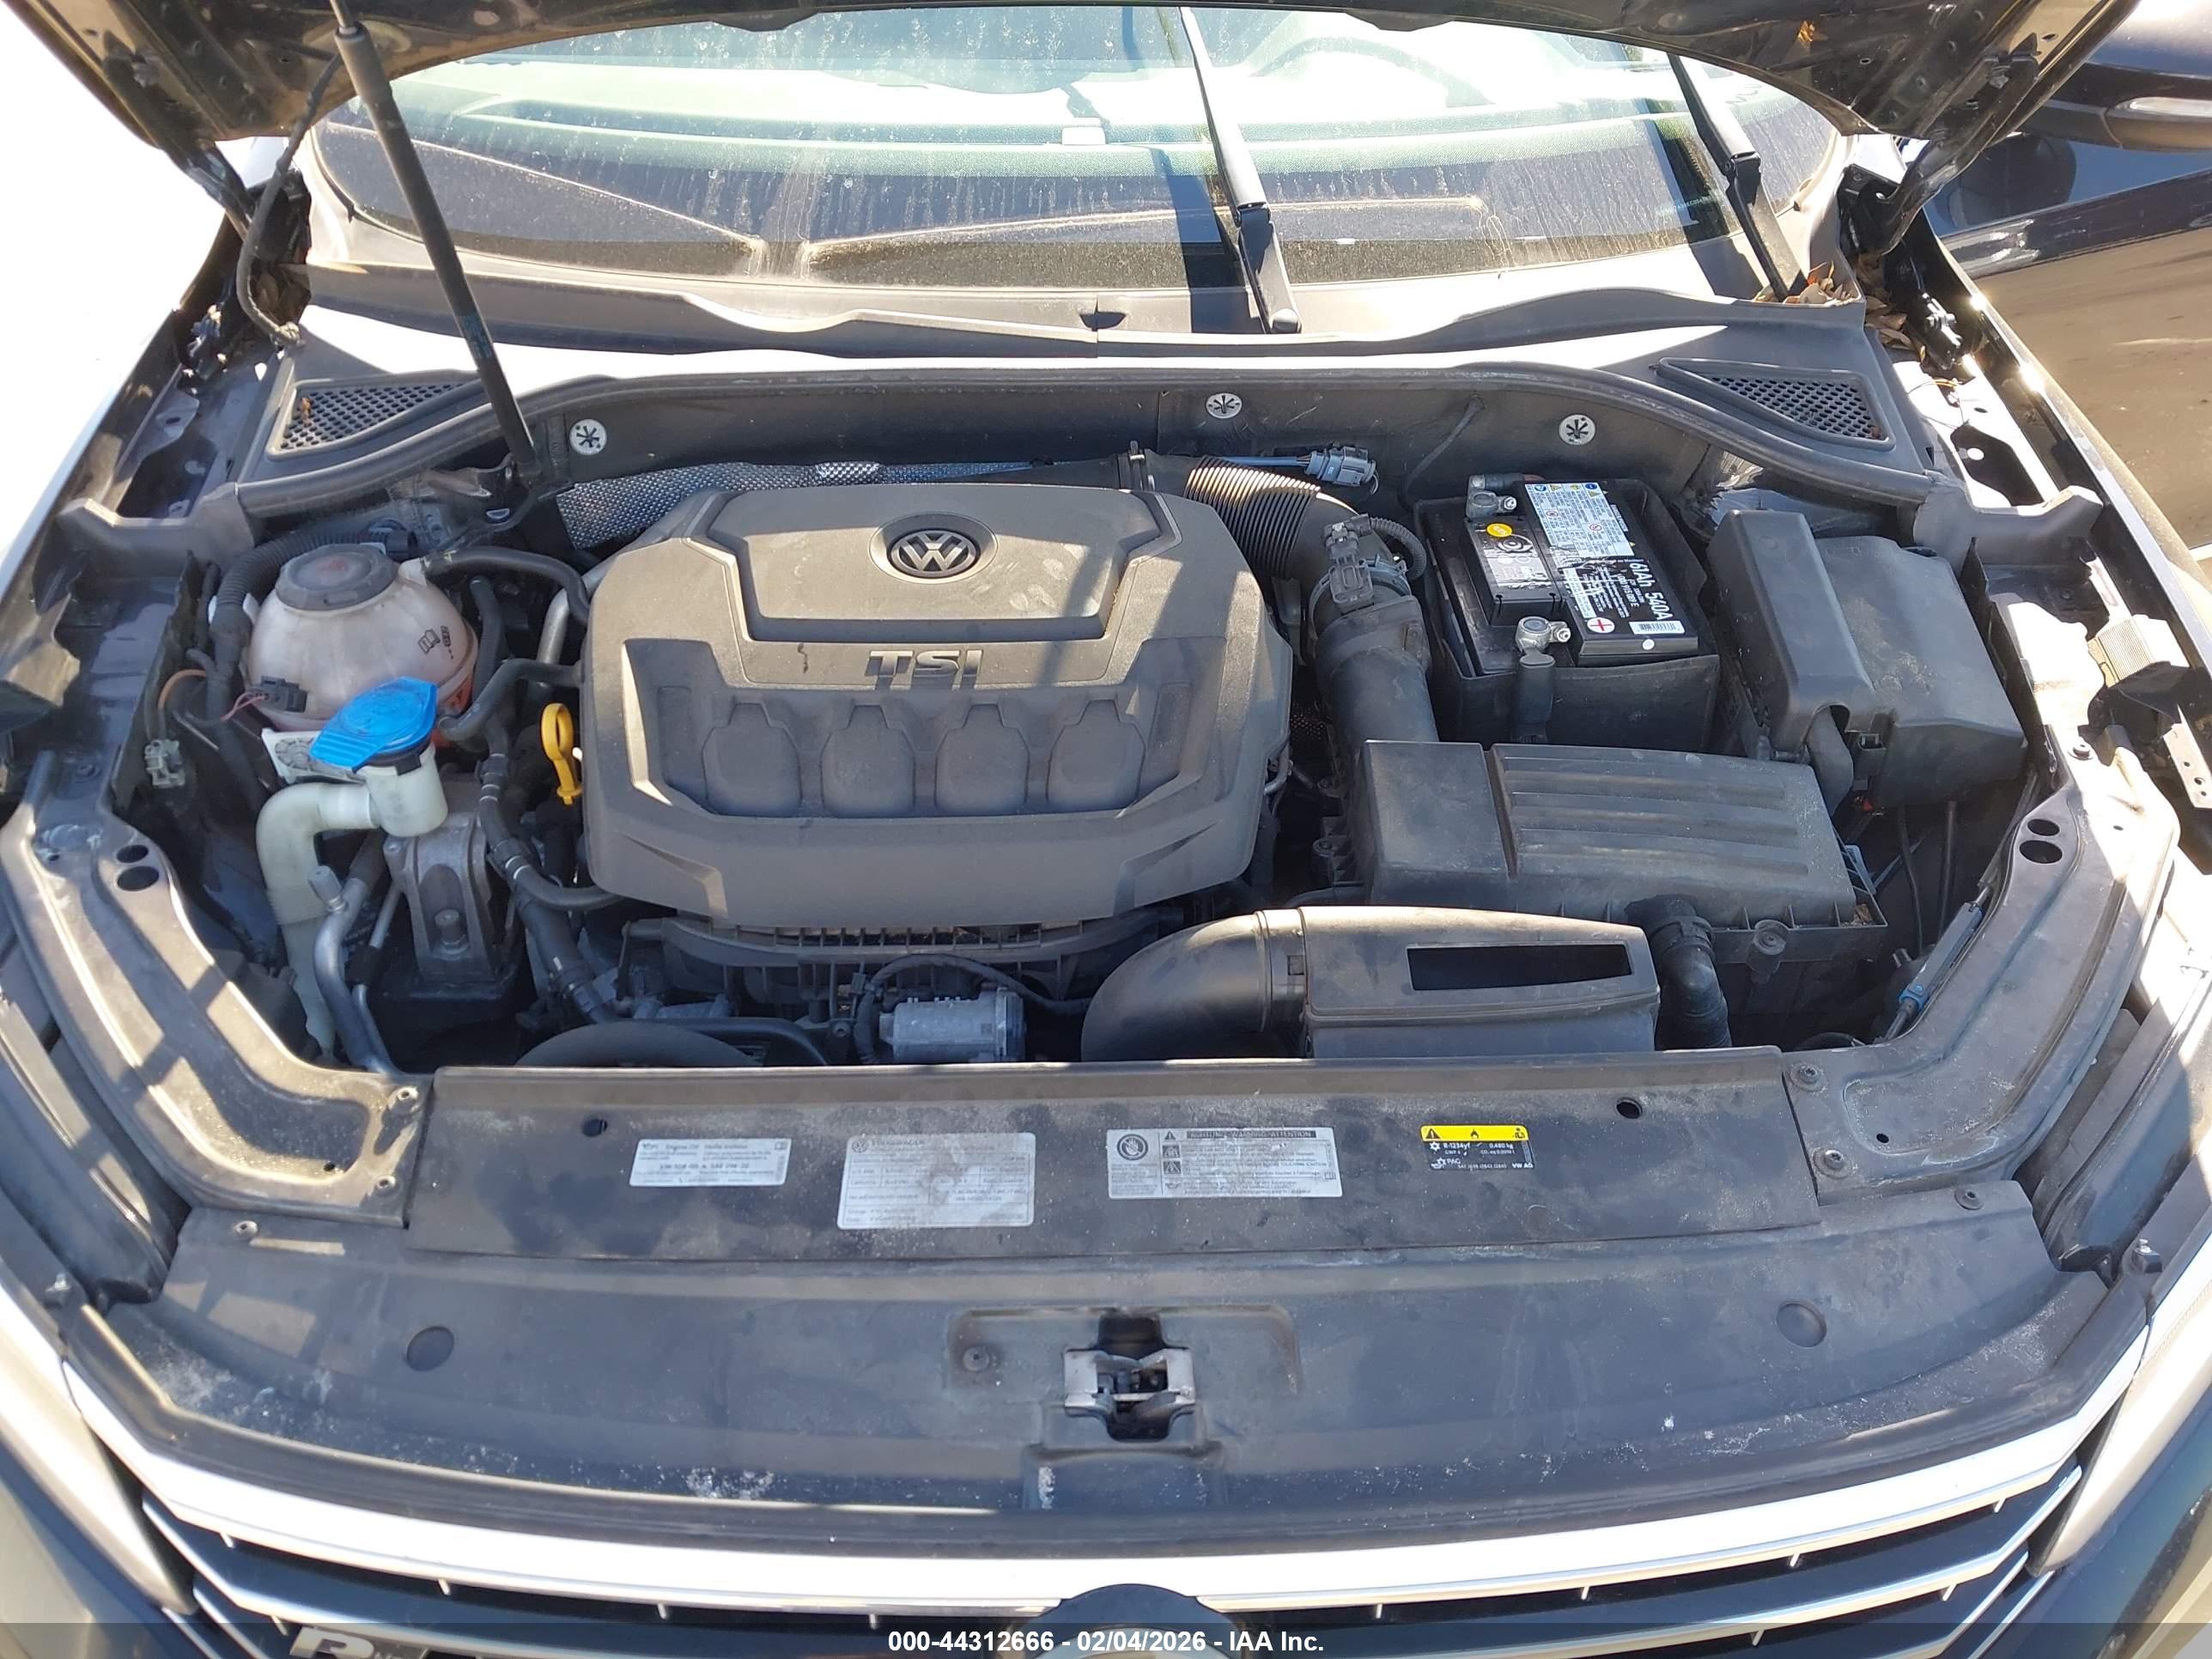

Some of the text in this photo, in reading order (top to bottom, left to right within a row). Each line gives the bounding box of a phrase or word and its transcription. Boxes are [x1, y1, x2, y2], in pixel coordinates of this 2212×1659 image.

[1630, 562, 1674, 620] 61Ah 540A
[865, 649, 983, 678] TSI
